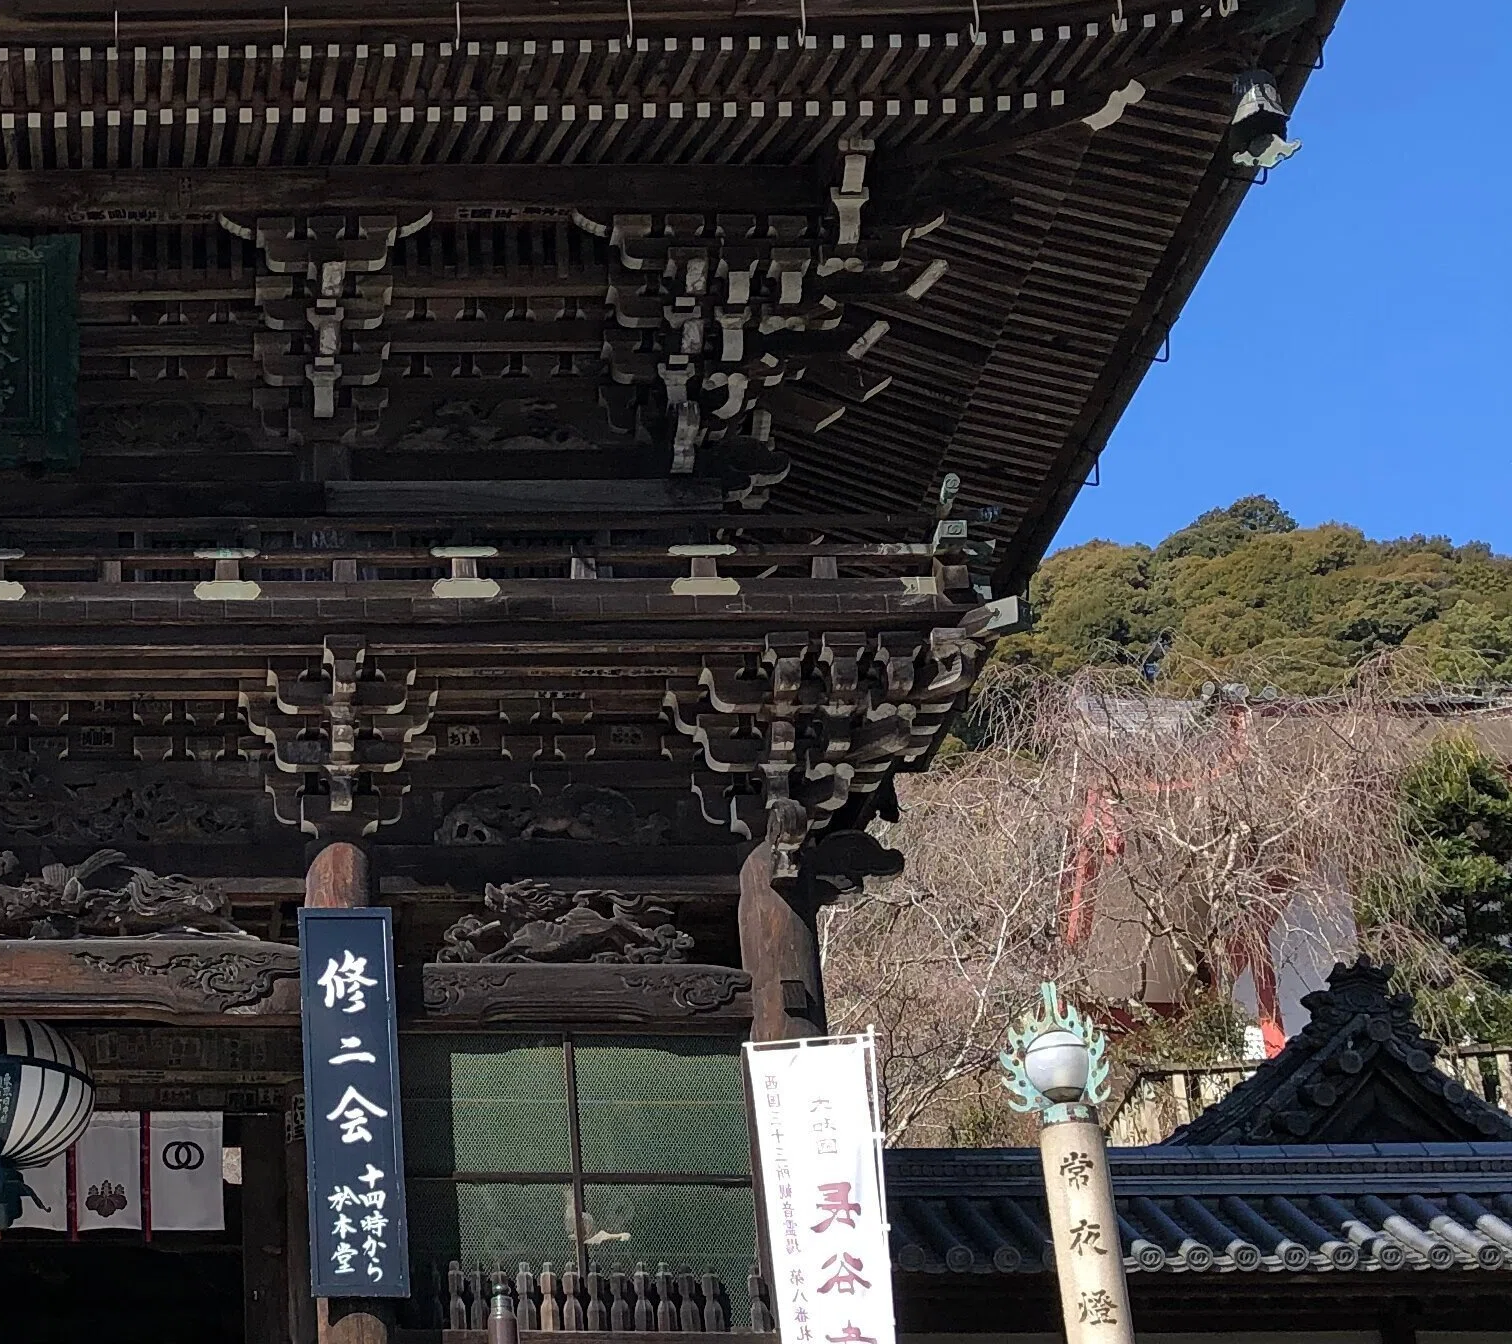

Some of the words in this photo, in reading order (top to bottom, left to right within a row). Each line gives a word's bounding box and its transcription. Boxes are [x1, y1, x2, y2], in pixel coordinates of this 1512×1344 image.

[316, 949, 388, 1144] 修二会
[327, 1184, 361, 1274] 於本堂
[357, 1163, 389, 1283] 十四時から
[1059, 1151, 1119, 1327] 常夜燈
